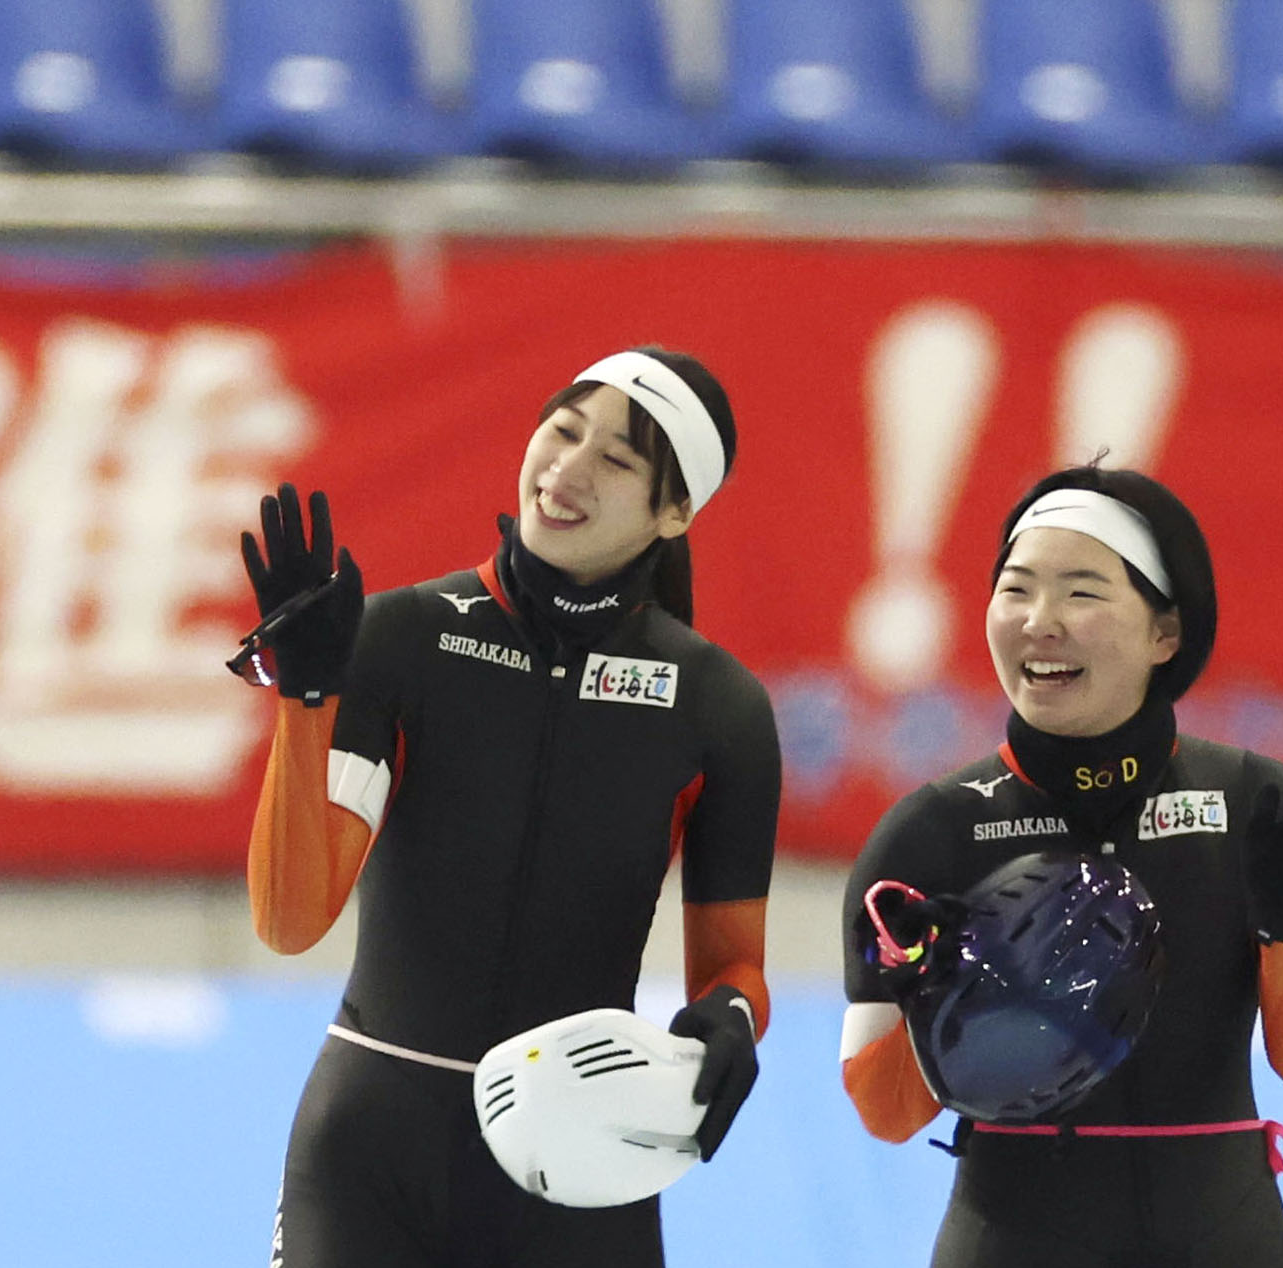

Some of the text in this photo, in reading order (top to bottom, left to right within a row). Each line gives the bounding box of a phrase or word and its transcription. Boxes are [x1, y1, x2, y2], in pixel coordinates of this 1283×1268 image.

[438, 632, 532, 673] SHIRAKABA
[585, 659, 672, 703] 北海道
[973, 816, 1069, 841] SHIRAKABA
[1143, 793, 1223, 836] 北海道
